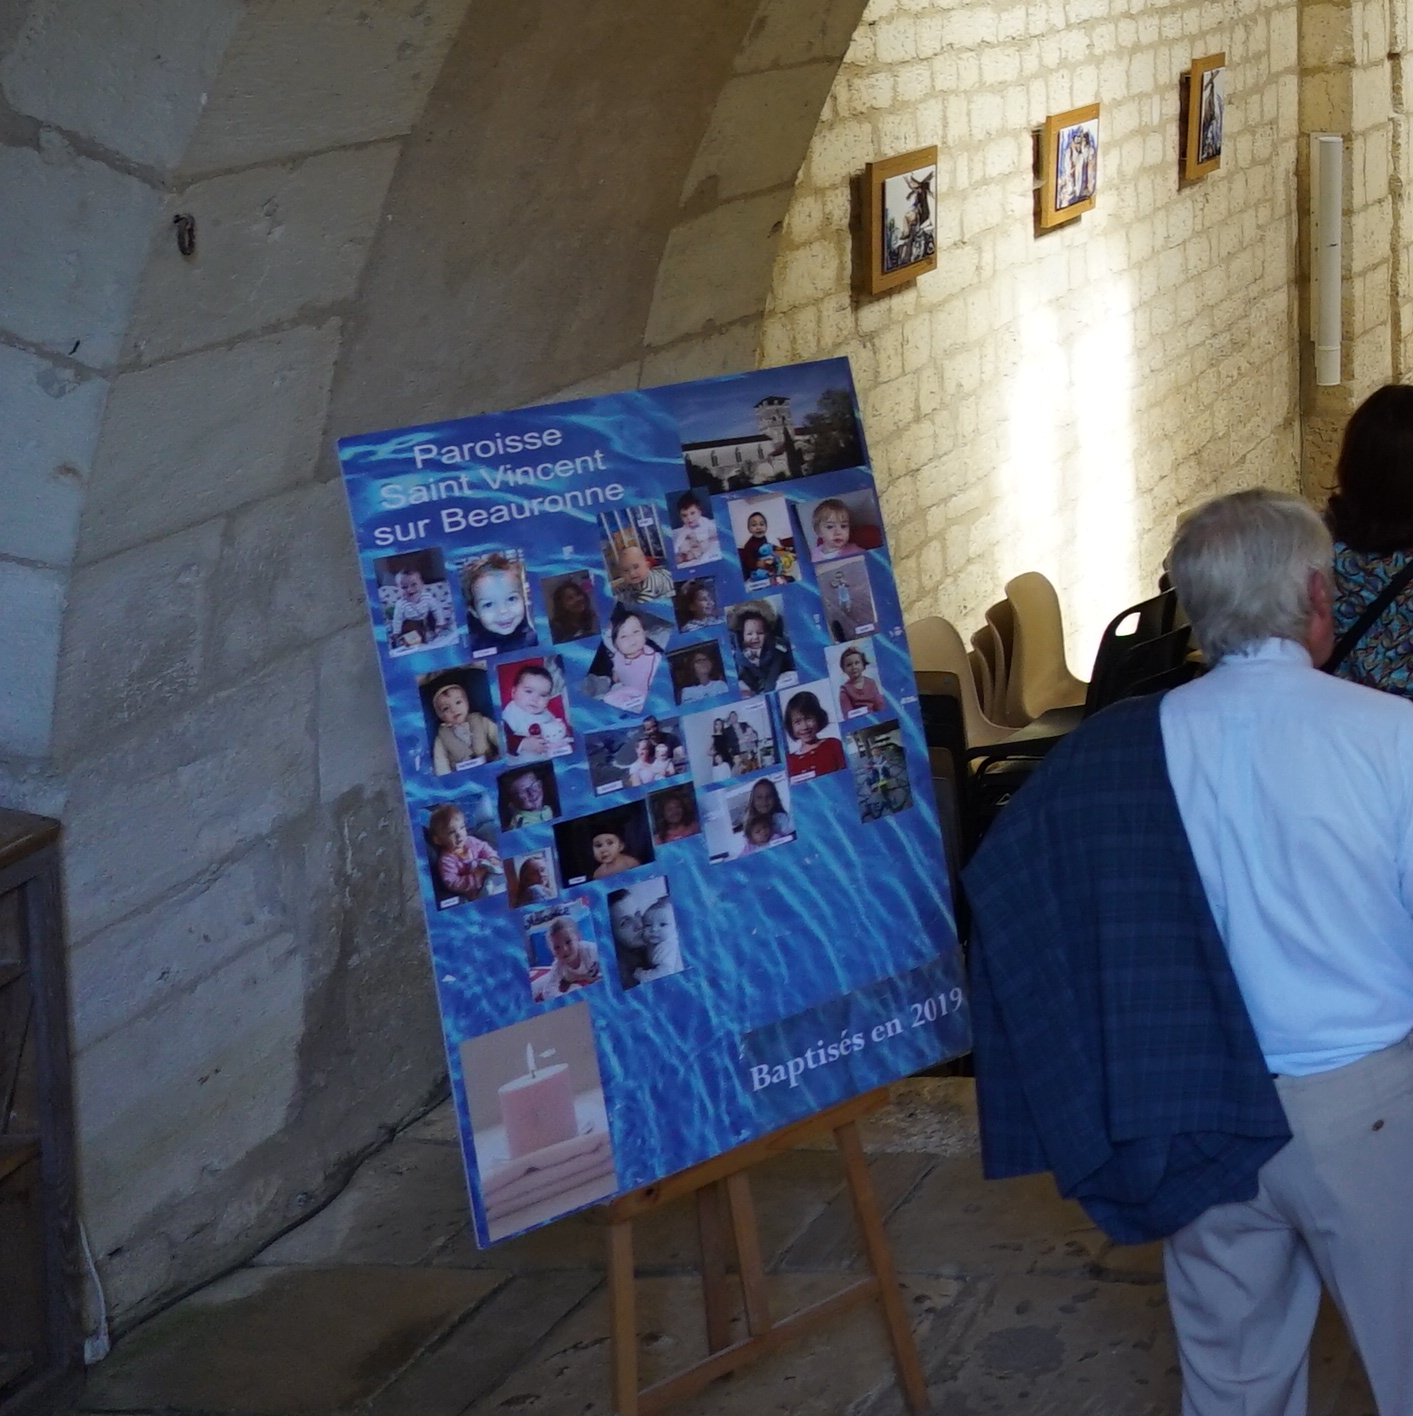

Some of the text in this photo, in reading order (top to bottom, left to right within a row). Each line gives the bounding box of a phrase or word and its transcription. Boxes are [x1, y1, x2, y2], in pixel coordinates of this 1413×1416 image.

[380, 449, 607, 510] Saint Vincent
[413, 428, 563, 470] Paroisse
[373, 482, 625, 546] sur Beauronne
[749, 986, 964, 1093] Baptisés en 2019
